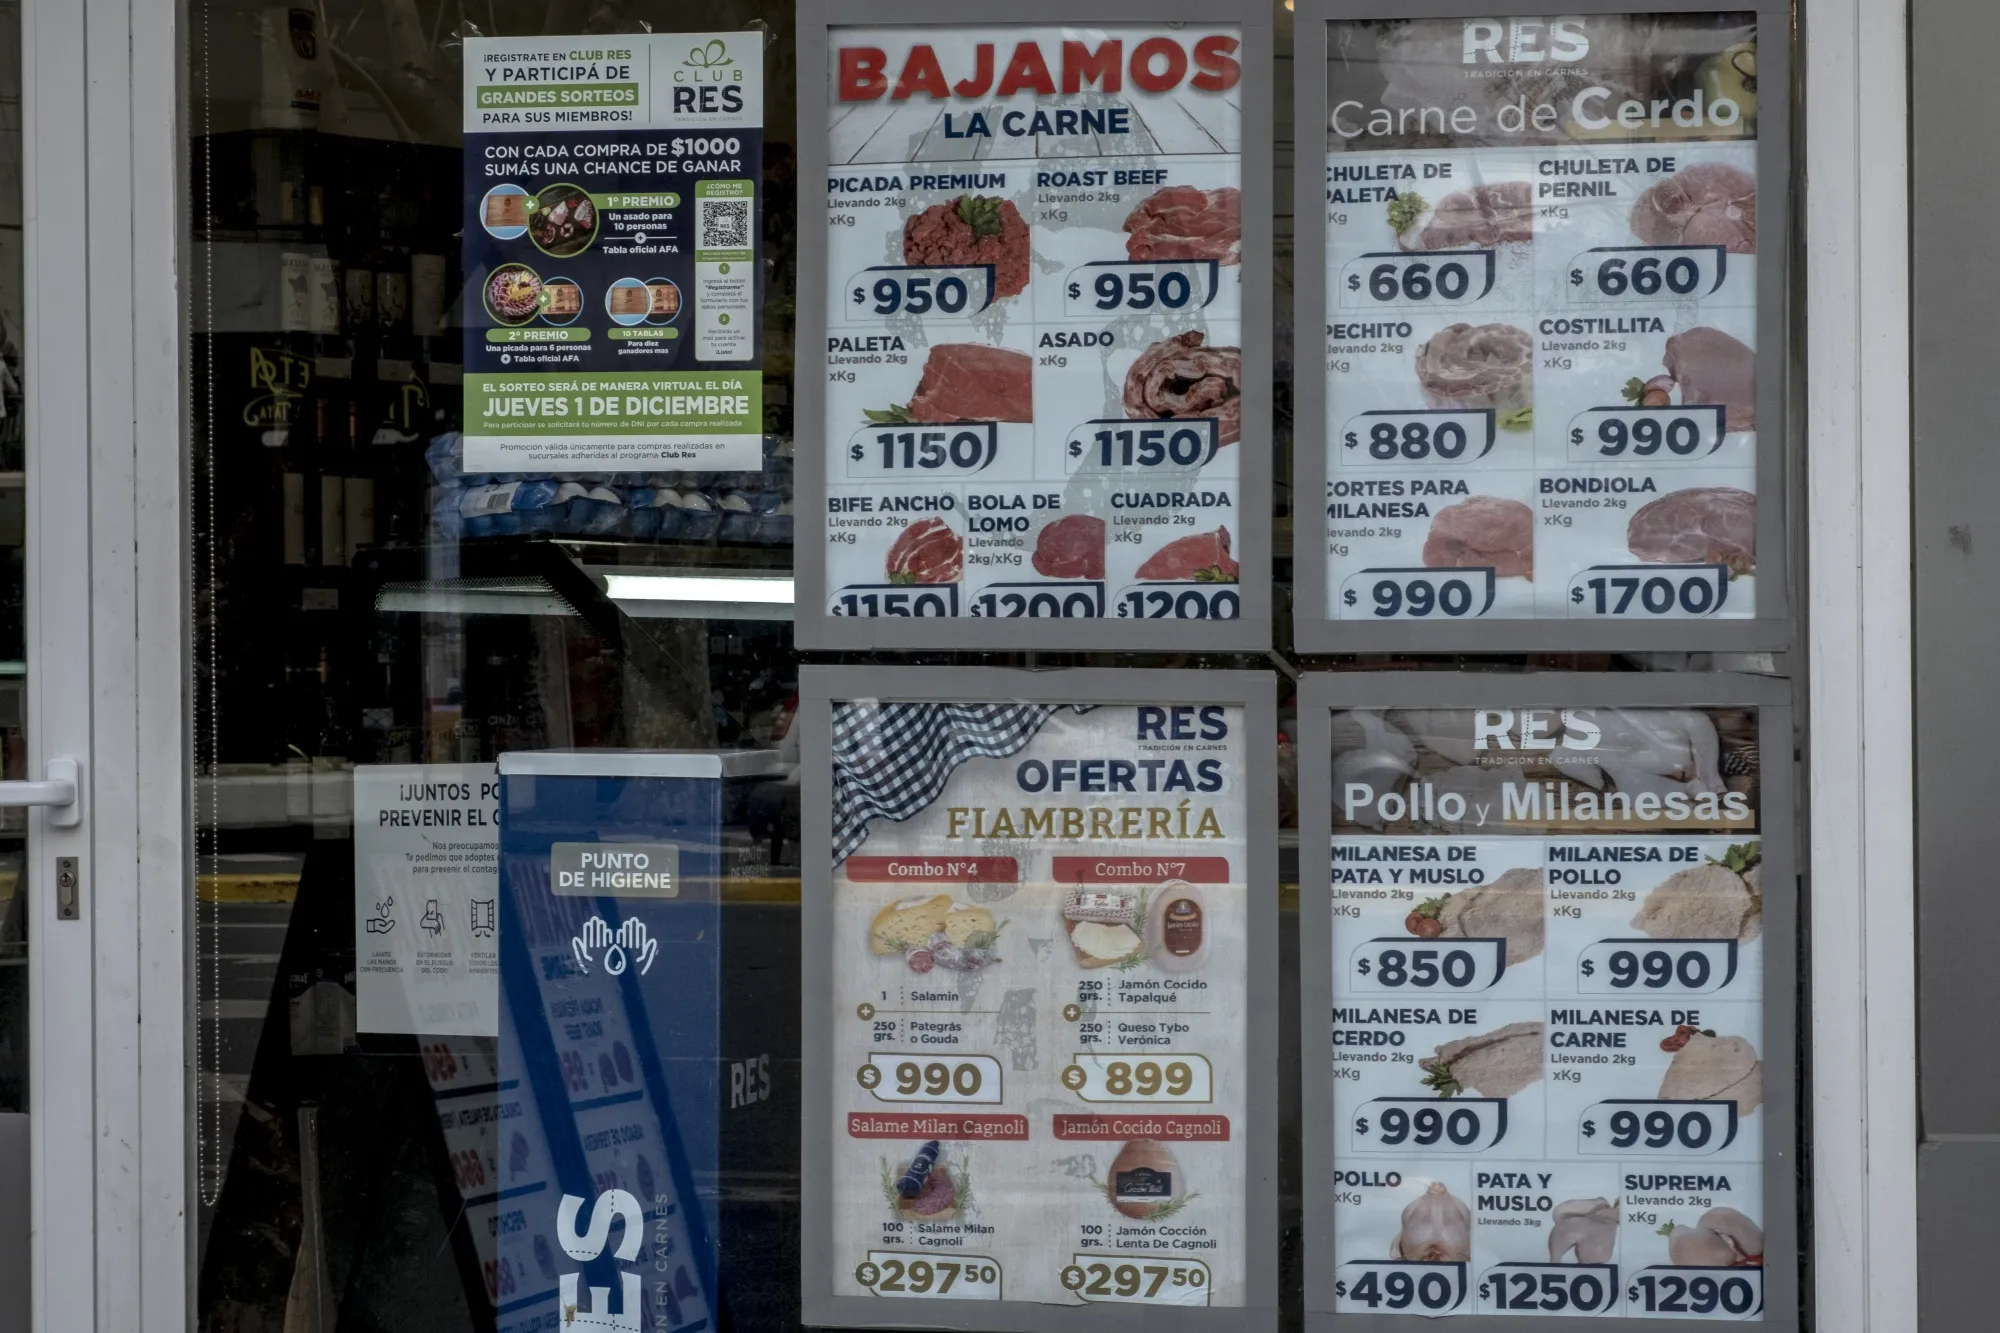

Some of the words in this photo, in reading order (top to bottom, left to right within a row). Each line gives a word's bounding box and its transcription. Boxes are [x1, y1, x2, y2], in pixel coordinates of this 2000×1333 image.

[1463, 16, 1589, 64] RES
[484, 54, 550, 62] ¡REGISTRATE
[552, 53, 566, 61] EN
[569, 51, 604, 60] CLUB
[607, 50, 631, 60] RES
[486, 69, 496, 82] Y
[504, 63, 599, 81] PARTICIPÁ
[607, 66, 629, 79] DE
[839, 36, 1241, 100] BAJAMOS
[1527, 68, 1541, 77] EN
[1545, 67, 1588, 76] CARNES
[482, 91, 556, 104] GRANDES
[561, 89, 634, 103] SORTEOS
[673, 85, 743, 114] RES
[483, 113, 521, 124] PARA
[525, 112, 550, 123] SUS
[555, 111, 633, 122] MIEMBROS!
[1332, 100, 1477, 139] Carne
[1498, 95, 1558, 133] de
[1572, 86, 1740, 130] Cerdo
[945, 113, 991, 138] LA
[1002, 109, 1129, 137] CARNE
[485, 146, 520, 158] CON
[524, 145, 569, 158] CADA
[574, 144, 642, 157] COMPRA
[646, 144, 667, 156] DE
[671, 138, 740, 156] $1000
[1539, 159, 1639, 176] CHULETA
[1646, 157, 1675, 174] DE
[828, 176, 902, 193] PICADA
[910, 174, 1005, 190] PREMIUM
[1037, 171, 1105, 188] ROAST
[1114, 170, 1168, 186] BEEF
[1539, 180, 1616, 198] PERNIL
[623, 196, 674, 207] PREMIO
[828, 198, 881, 209] Llevando
[885, 197, 906, 208] 2kg
[829, 214, 855, 227] xKg
[603, 246, 627, 254] Tabla
[629, 245, 657, 254] oficial
[660, 245, 678, 253] AFA
[524, 330, 569, 340] PREMIO
[633, 329, 663, 337] TABLAS
[1539, 318, 1665, 336] COSTILLITA
[828, 336, 905, 352] PALETA
[1039, 331, 1114, 347] ASADO
[1541, 341, 1599, 351] Llevando
[1604, 340, 1626, 351] 2kg
[1544, 357, 1572, 370] xKg
[483, 397, 568, 418] JUEVES
[576, 398, 582, 416] 1
[590, 397, 620, 416] DE
[626, 395, 749, 415] DICIEMBRE
[500, 443, 543, 451] Promoción
[545, 443, 567, 451] válida
[570, 442, 615, 451] únicamente
[618, 444, 637, 452] para
[640, 443, 671, 452] compras
[674, 442, 712, 450] realizadas
[571, 452, 609, 460] adheridas
[620, 453, 658, 461] programa
[661, 451, 679, 459] Club
[1540, 477, 1656, 494] BONDIOLA
[829, 498, 873, 512] BIFE
[879, 496, 955, 511] ANCHO
[968, 495, 1026, 511] BOLA
[1033, 494, 1060, 509] DE
[1111, 492, 1231, 508] CUADRADA
[969, 517, 1029, 532] LOMO
[969, 537, 1024, 548] Llevando
[968, 552, 1022, 566] 2kg/xKg
[1137, 705, 1228, 741] RES
[1474, 709, 1601, 750] RES
[1016, 759, 1223, 793] OFERTAS
[400, 783, 470, 802] ¡JUNTOS
[1344, 782, 1467, 821] Pollo
[1475, 801, 1490, 826] y
[1503, 781, 1749, 821] Milanesas
[380, 809, 461, 827] PREVENIR
[468, 809, 487, 827] EL
[946, 799, 1225, 840] FIAMBRERÍA
[433, 842, 445, 850] Nos
[1549, 846, 1662, 862] MILANESA
[1669, 846, 1698, 862] DE
[416, 854, 446, 863] pedimos
[449, 855, 461, 863] que
[464, 853, 495, 863] adoptes
[581, 853, 649, 869] PUNTO
[888, 862, 943, 876] Combo
[1096, 862, 1151, 876] Combo
[1549, 869, 1621, 885] POLLO
[559, 872, 584, 887] DE
[591, 872, 671, 889] HIGIENE
[1118, 980, 1160, 990] Jamón
[1164, 979, 1207, 990] Cocido
[1118, 991, 1176, 1005] Tapalqué
[731, 1053, 770, 1109] RES
[852, 1119, 909, 1133] Salame
[913, 1120, 958, 1134] Milan
[963, 1120, 1024, 1138] Cagnoli
[1062, 1119, 1108, 1135] Jamón
[1113, 1120, 1161, 1135] Cocido
[1166, 1121, 1221, 1138] Cagnoli
[1477, 1173, 1530, 1189] PATA
[1537, 1173, 1552, 1189] Y
[1625, 1174, 1731, 1191] SUPREMA
[1478, 1195, 1553, 1212] MUSLO
[655, 1194, 668, 1272] CARNES
